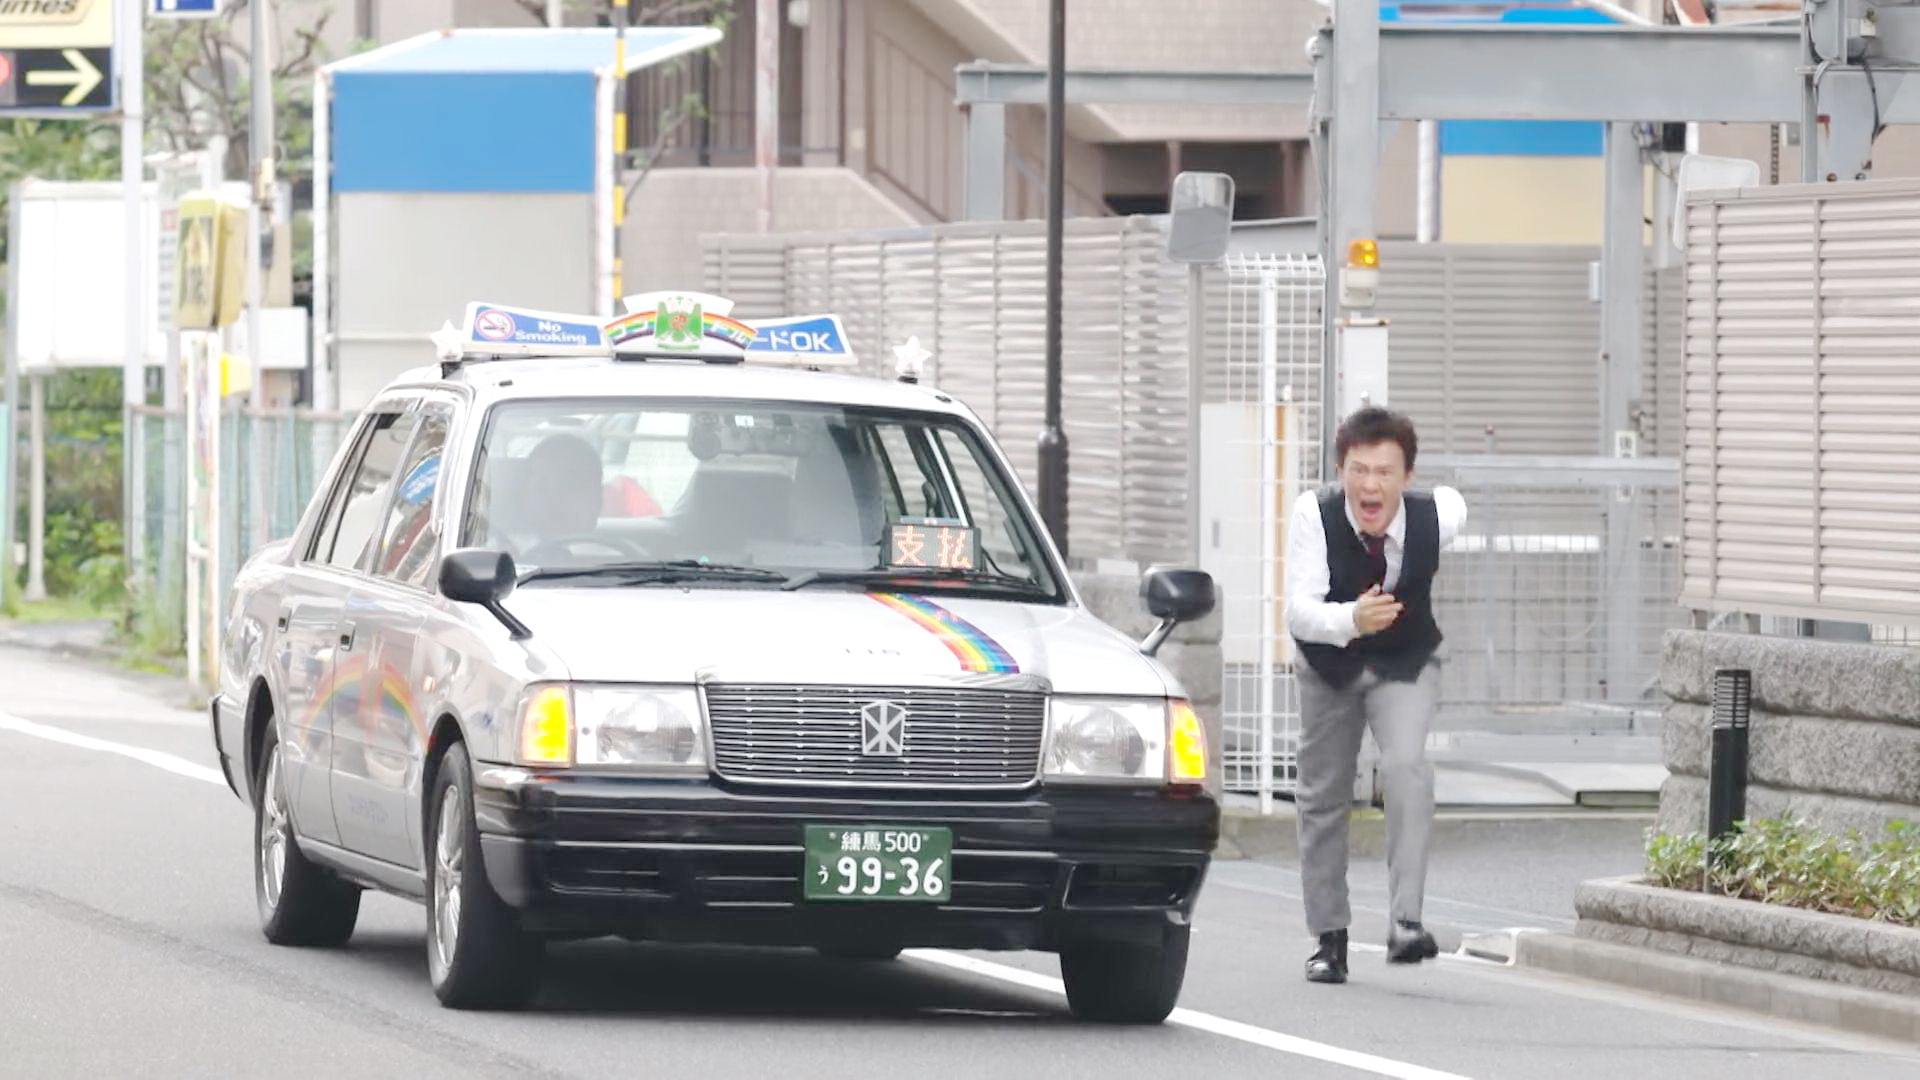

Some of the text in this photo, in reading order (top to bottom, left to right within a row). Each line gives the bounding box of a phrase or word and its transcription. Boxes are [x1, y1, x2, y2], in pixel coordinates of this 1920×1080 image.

[0, 0, 77, 14] imes
[537, 321, 562, 332] No
[515, 332, 587, 345] Smoking
[817, 856, 943, 895] う 99-36
